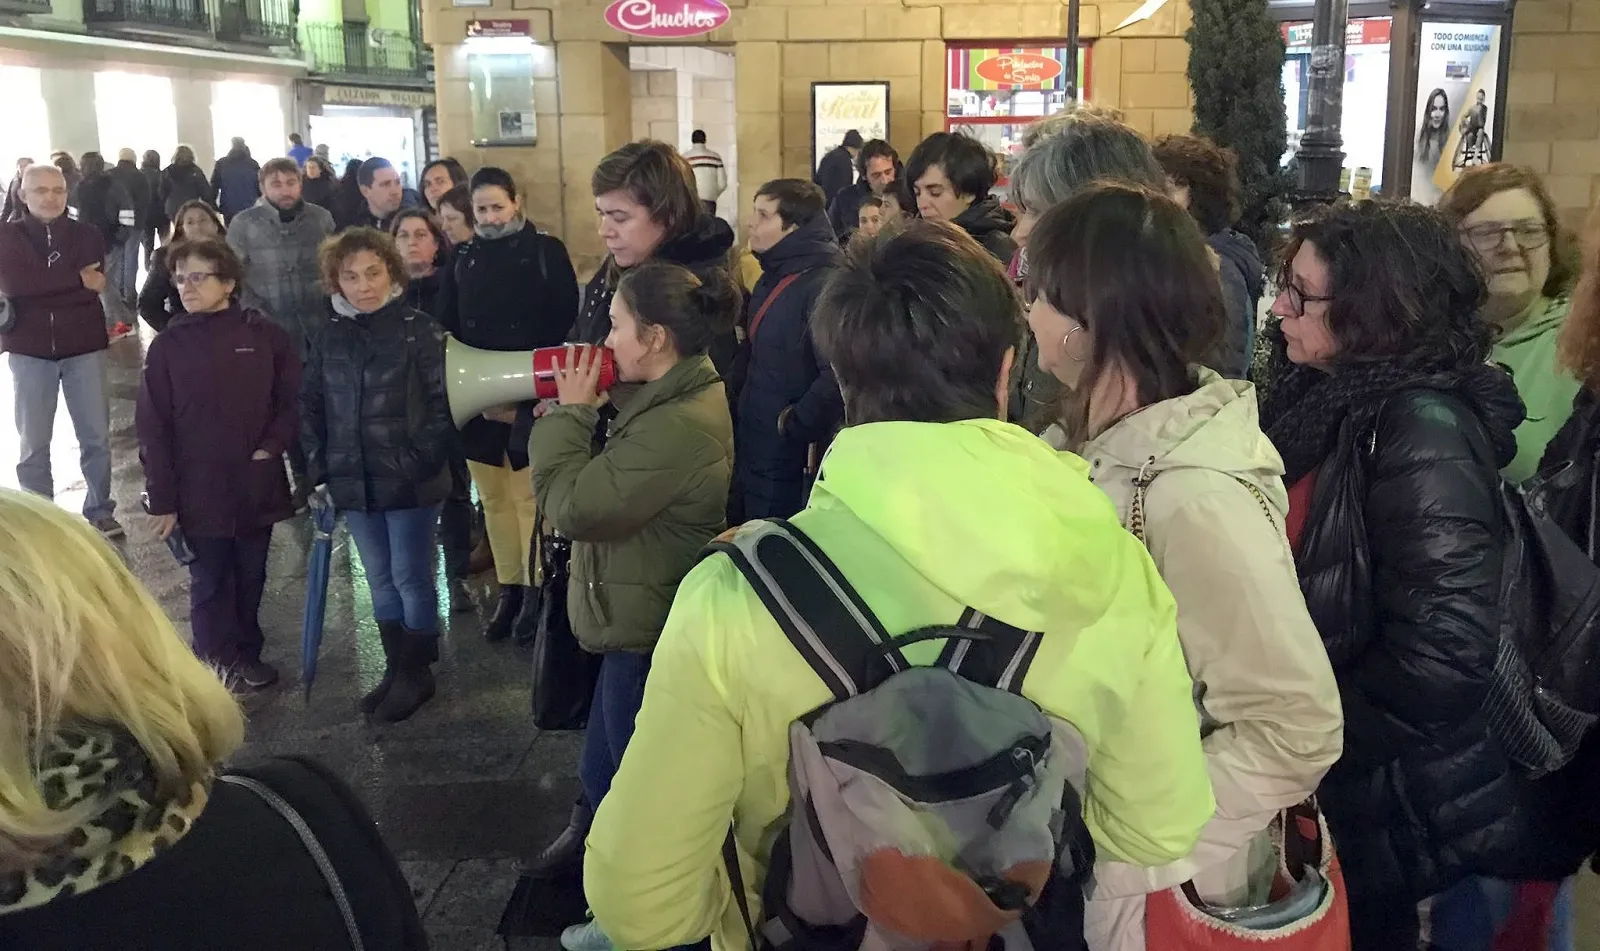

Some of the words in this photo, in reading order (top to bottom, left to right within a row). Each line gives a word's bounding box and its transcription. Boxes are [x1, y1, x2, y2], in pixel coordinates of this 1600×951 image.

[617, 0, 716, 30] Chuches
[1434, 32, 1452, 40] TODO
[1454, 33, 1488, 41] COMIENZA
[1431, 43, 1446, 51] CON
